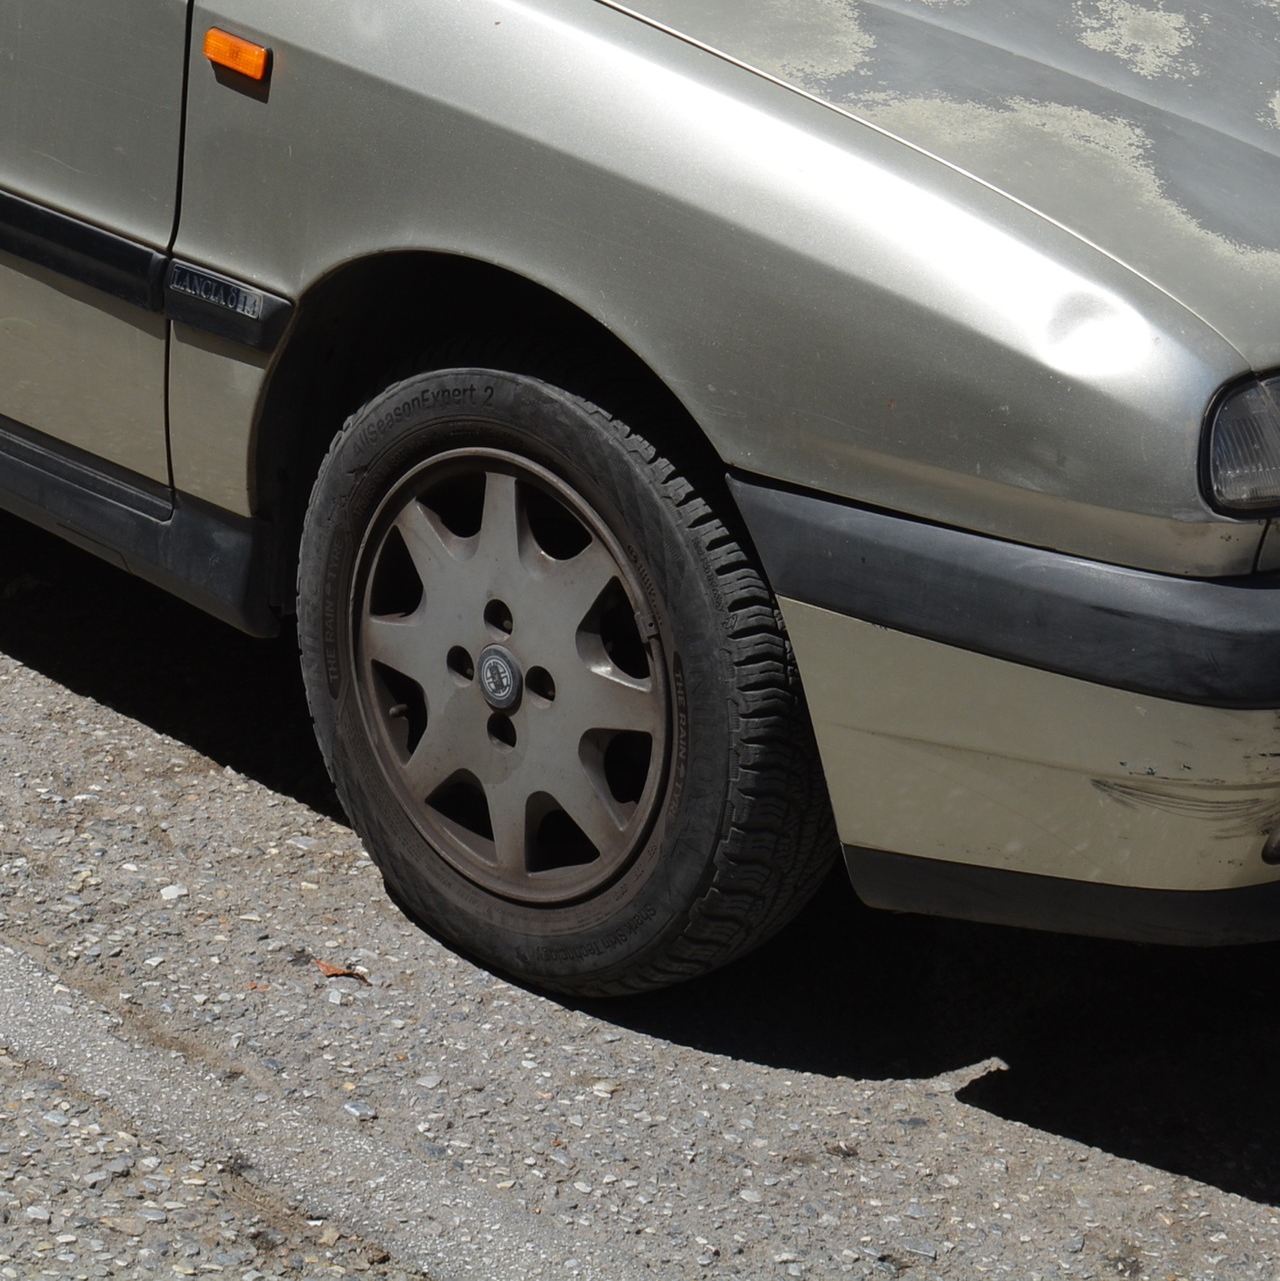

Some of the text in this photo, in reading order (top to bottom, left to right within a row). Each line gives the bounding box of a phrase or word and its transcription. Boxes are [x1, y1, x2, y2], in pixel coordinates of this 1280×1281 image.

[172, 269, 226, 305] LANCIA
[241, 295, 258, 317] 1.4
[353, 382, 477, 458] AllSeasonExpert
[482, 384, 495, 408] 2
[323, 537, 345, 683] THE RAIN TYRE
[666, 670, 688, 827] THE RAIN TYRE
[536, 902, 657, 964] Shark Skin Technology
